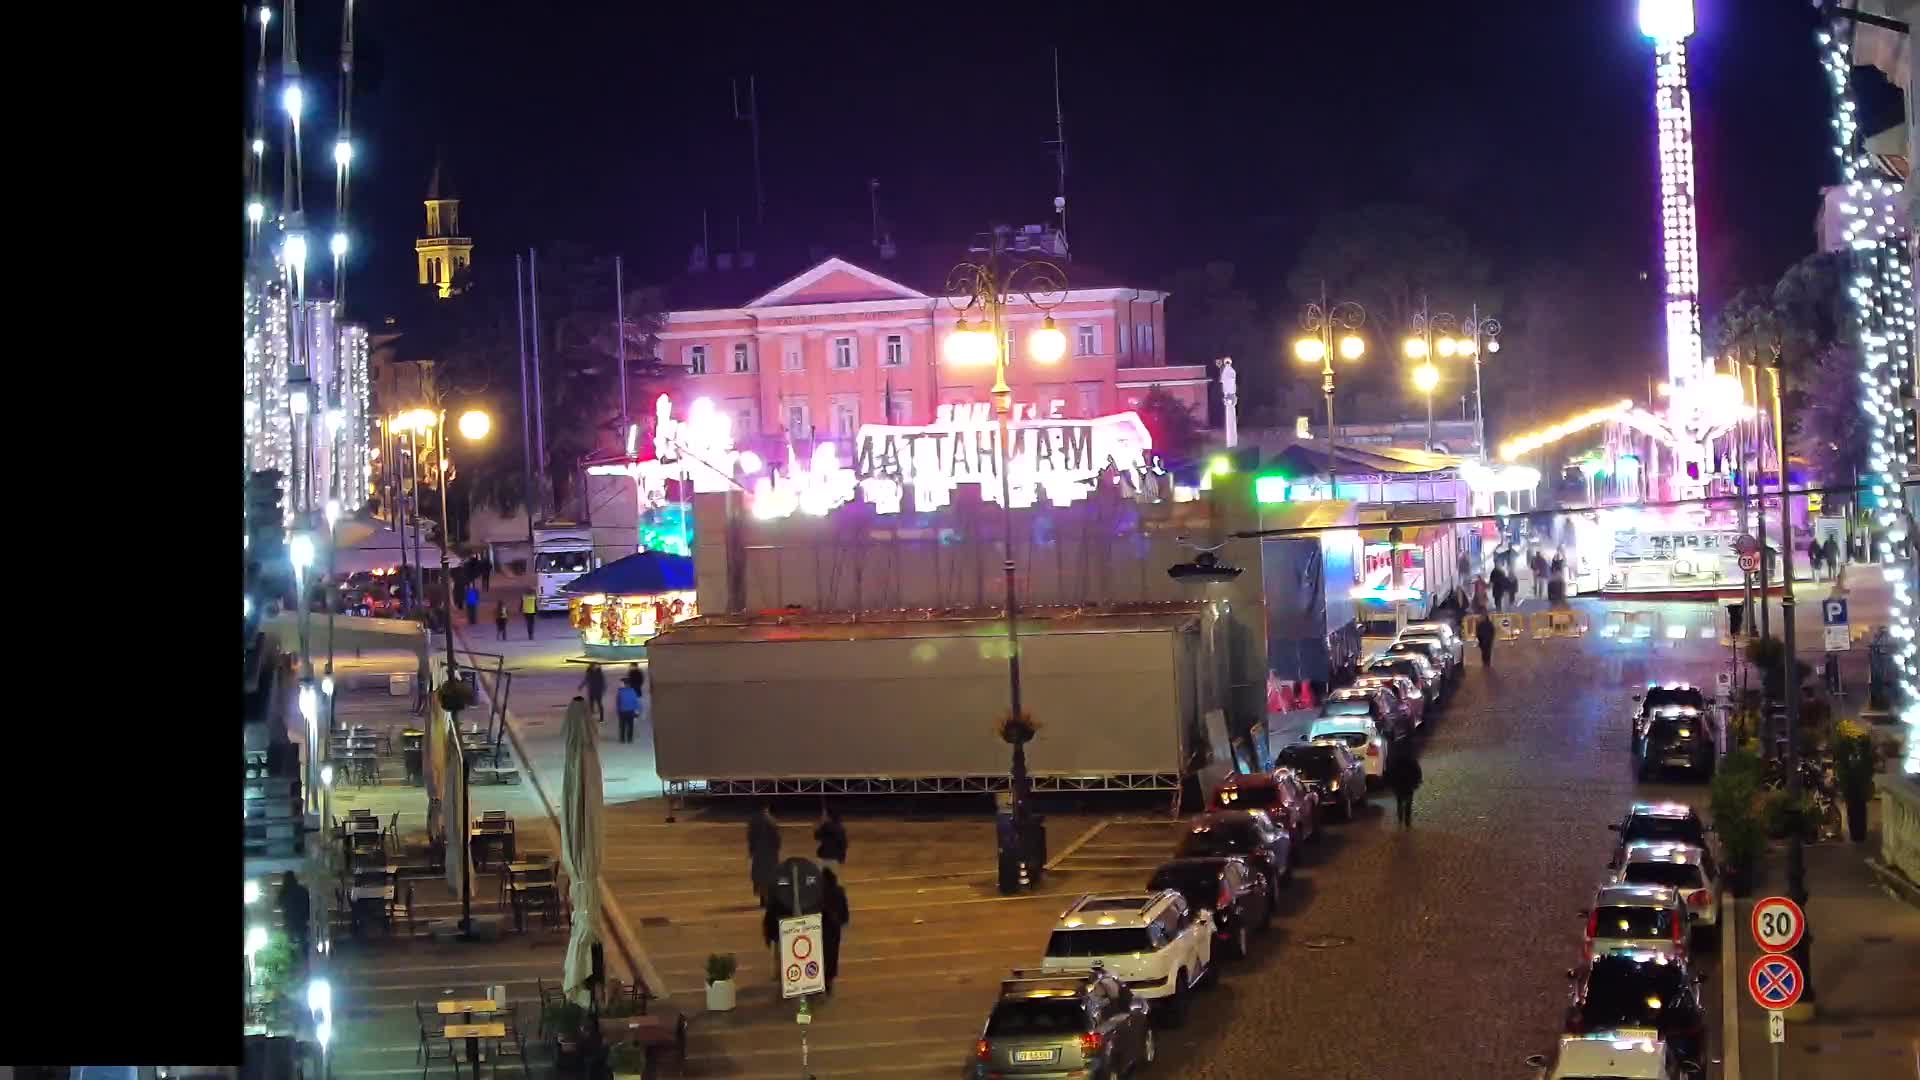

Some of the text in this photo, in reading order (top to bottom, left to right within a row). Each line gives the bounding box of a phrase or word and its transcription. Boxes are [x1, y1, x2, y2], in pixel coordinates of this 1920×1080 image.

[1743, 558, 1752, 567] 20
[1827, 603, 1842, 621] P
[1763, 912, 1791, 938] 30
